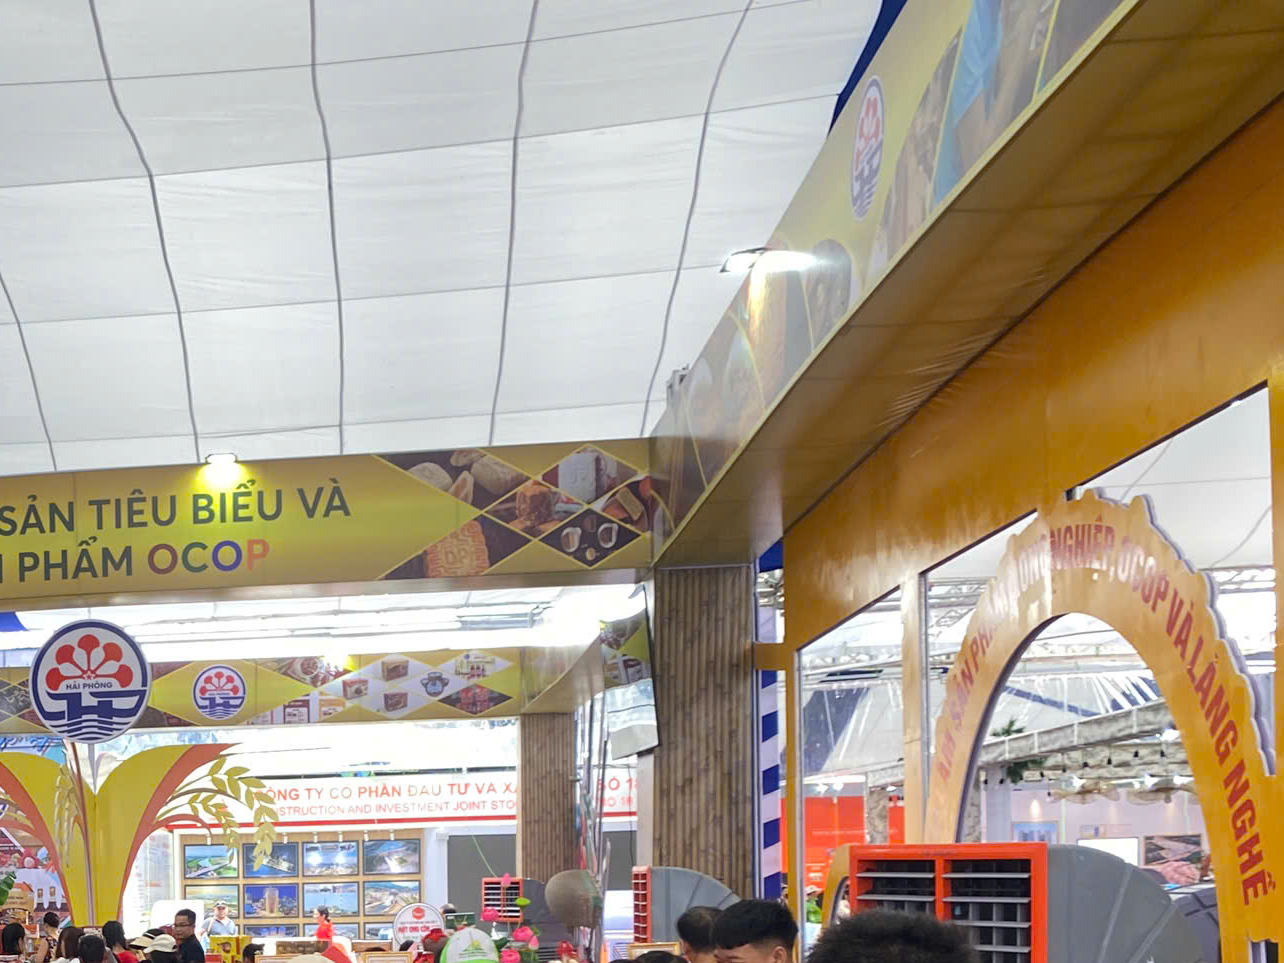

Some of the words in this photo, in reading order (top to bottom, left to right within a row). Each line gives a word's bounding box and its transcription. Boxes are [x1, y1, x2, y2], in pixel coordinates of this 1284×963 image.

[88, 489, 177, 530] TIÊU
[192, 479, 283, 524] BIỂU
[297, 478, 351, 519] VÀ
[19, 536, 132, 582] PHẨM
[148, 539, 270, 575] OCOP
[66, 680, 80, 690] HẢI
[82, 681, 113, 689] PHÒNG
[1117, 536, 1170, 613] OCOP
[1166, 588, 1196, 661] VÀ
[1186, 634, 1238, 766] LÀNG
[1223, 759, 1276, 906] NGHỀ
[305, 787, 324, 800] TY
[348, 805, 372, 814] AND
[376, 802, 451, 813] INVESTMENT
[453, 801, 486, 811] JOINT
[491, 800, 517, 810] STO
